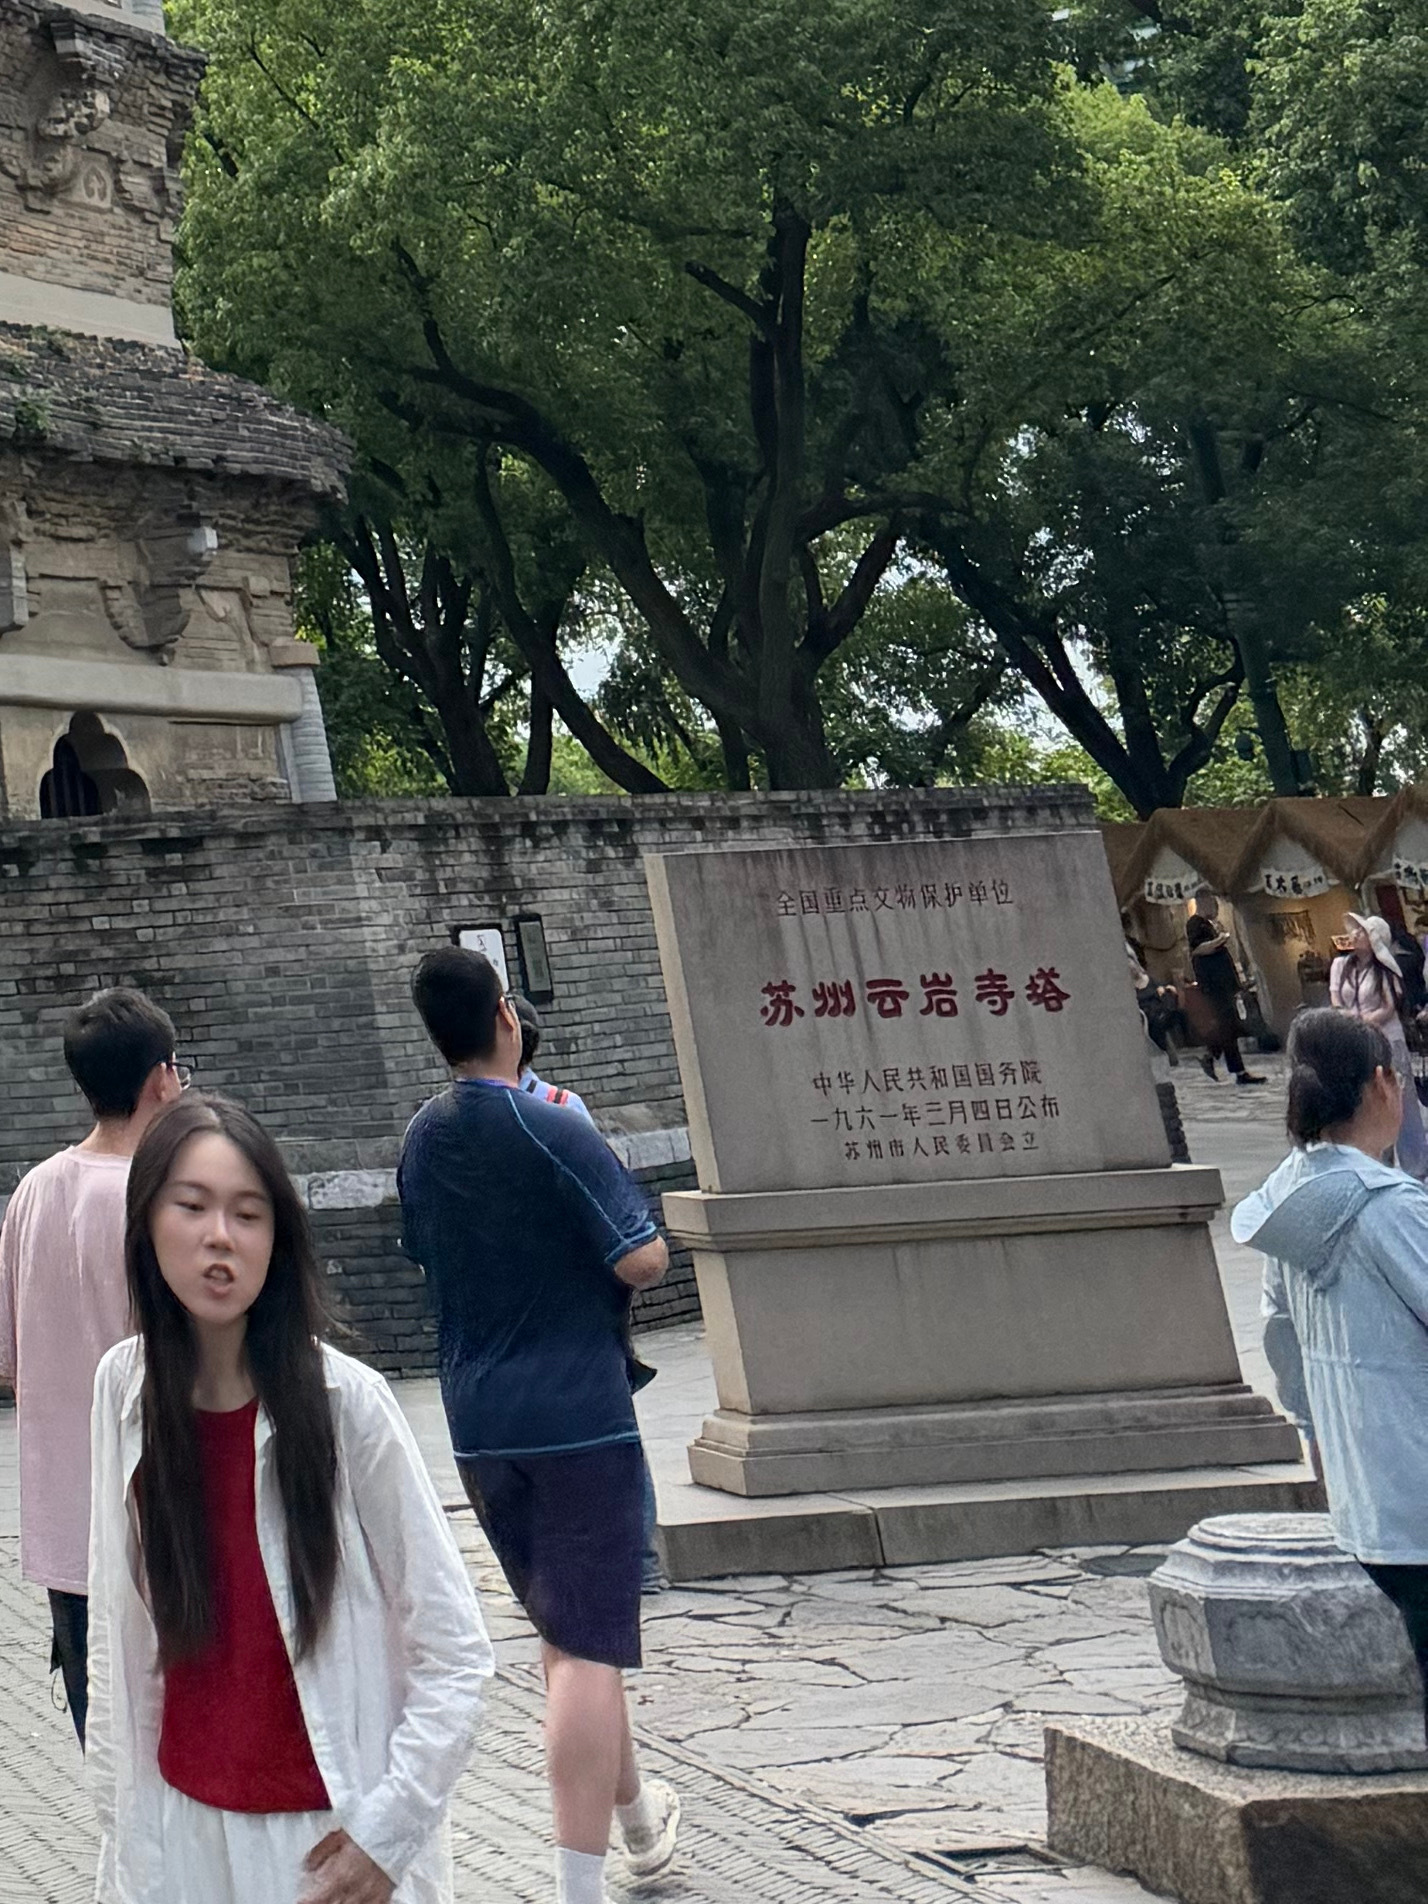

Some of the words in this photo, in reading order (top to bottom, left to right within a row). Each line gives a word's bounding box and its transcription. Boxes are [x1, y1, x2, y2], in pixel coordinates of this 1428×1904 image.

[777, 880, 1014, 916] 全国重点文物保护单位
[761, 967, 1070, 1027] 苏州云岩寺塔
[812, 1061, 1043, 1096] 中华人民共和国国务院
[810, 1095, 1060, 1131] 一九六一年三月四日公布
